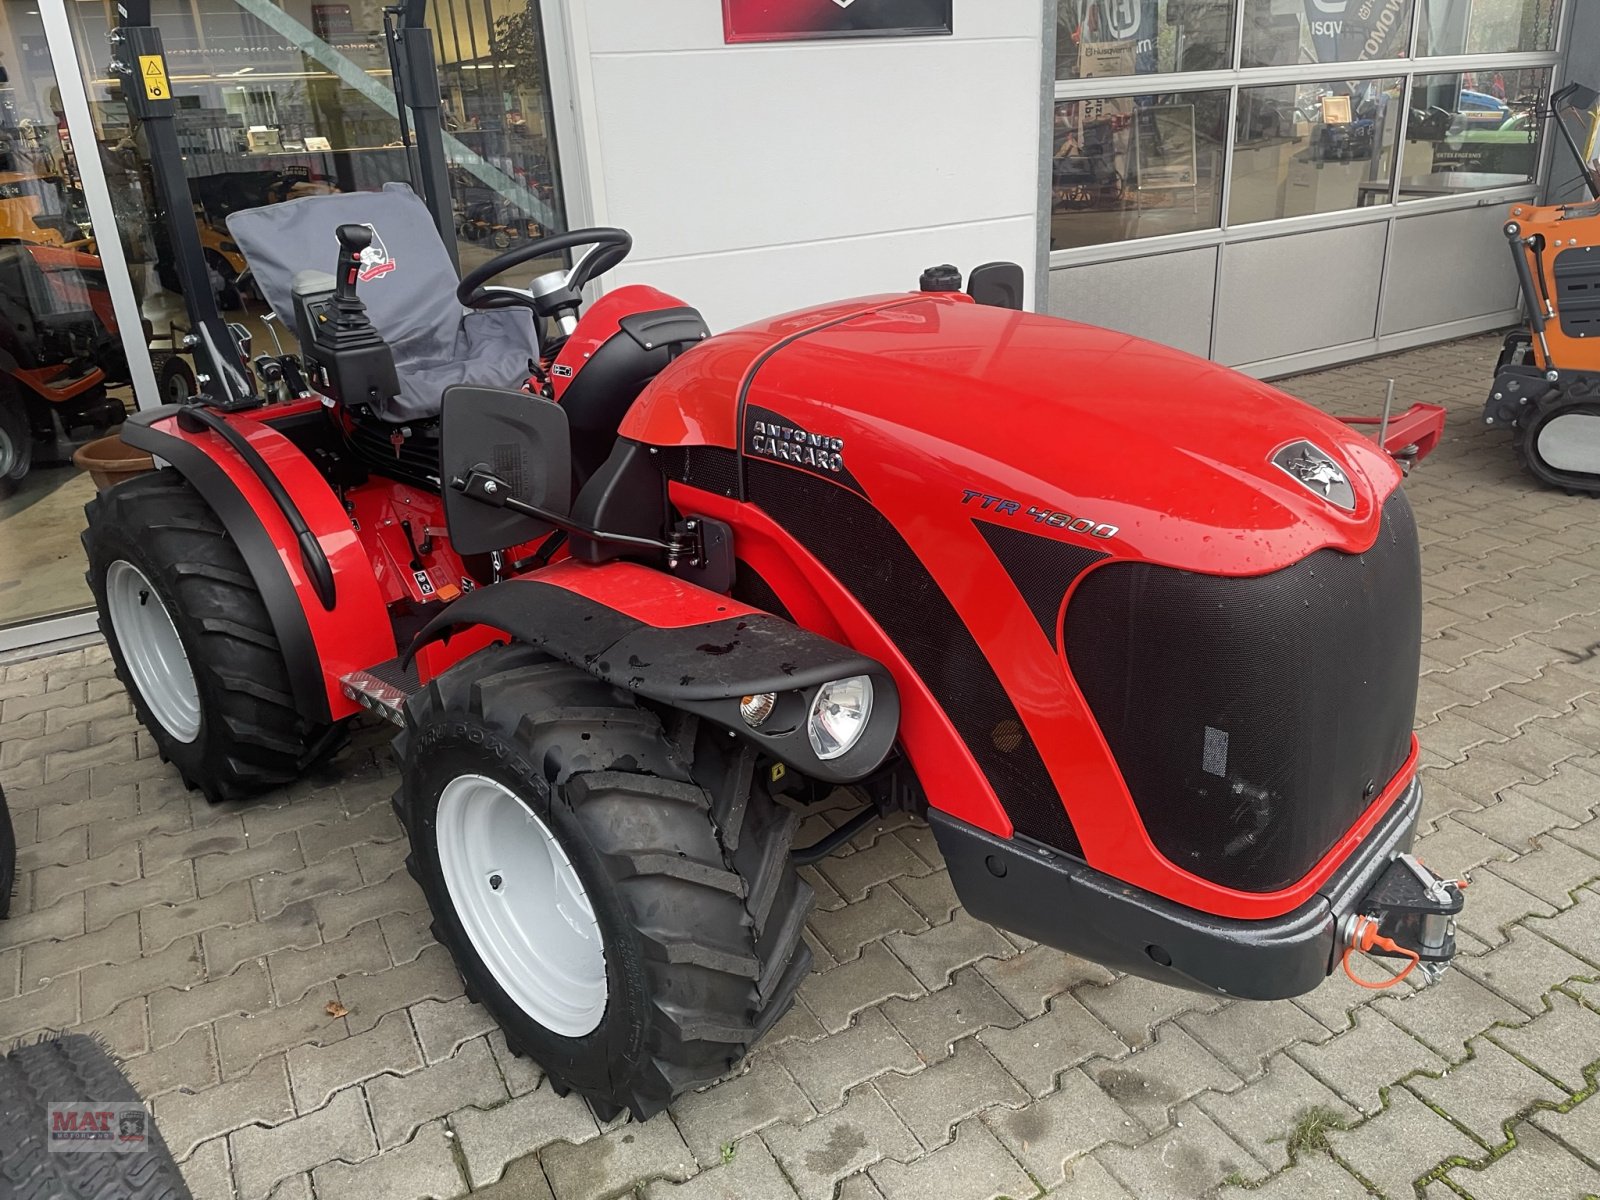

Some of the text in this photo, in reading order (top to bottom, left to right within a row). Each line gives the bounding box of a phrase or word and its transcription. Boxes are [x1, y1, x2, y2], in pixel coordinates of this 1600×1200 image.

[752, 435, 843, 472] CARRARO
[753, 421, 844, 451] ANTONIO
[961, 489, 1119, 539] TTR 4800
